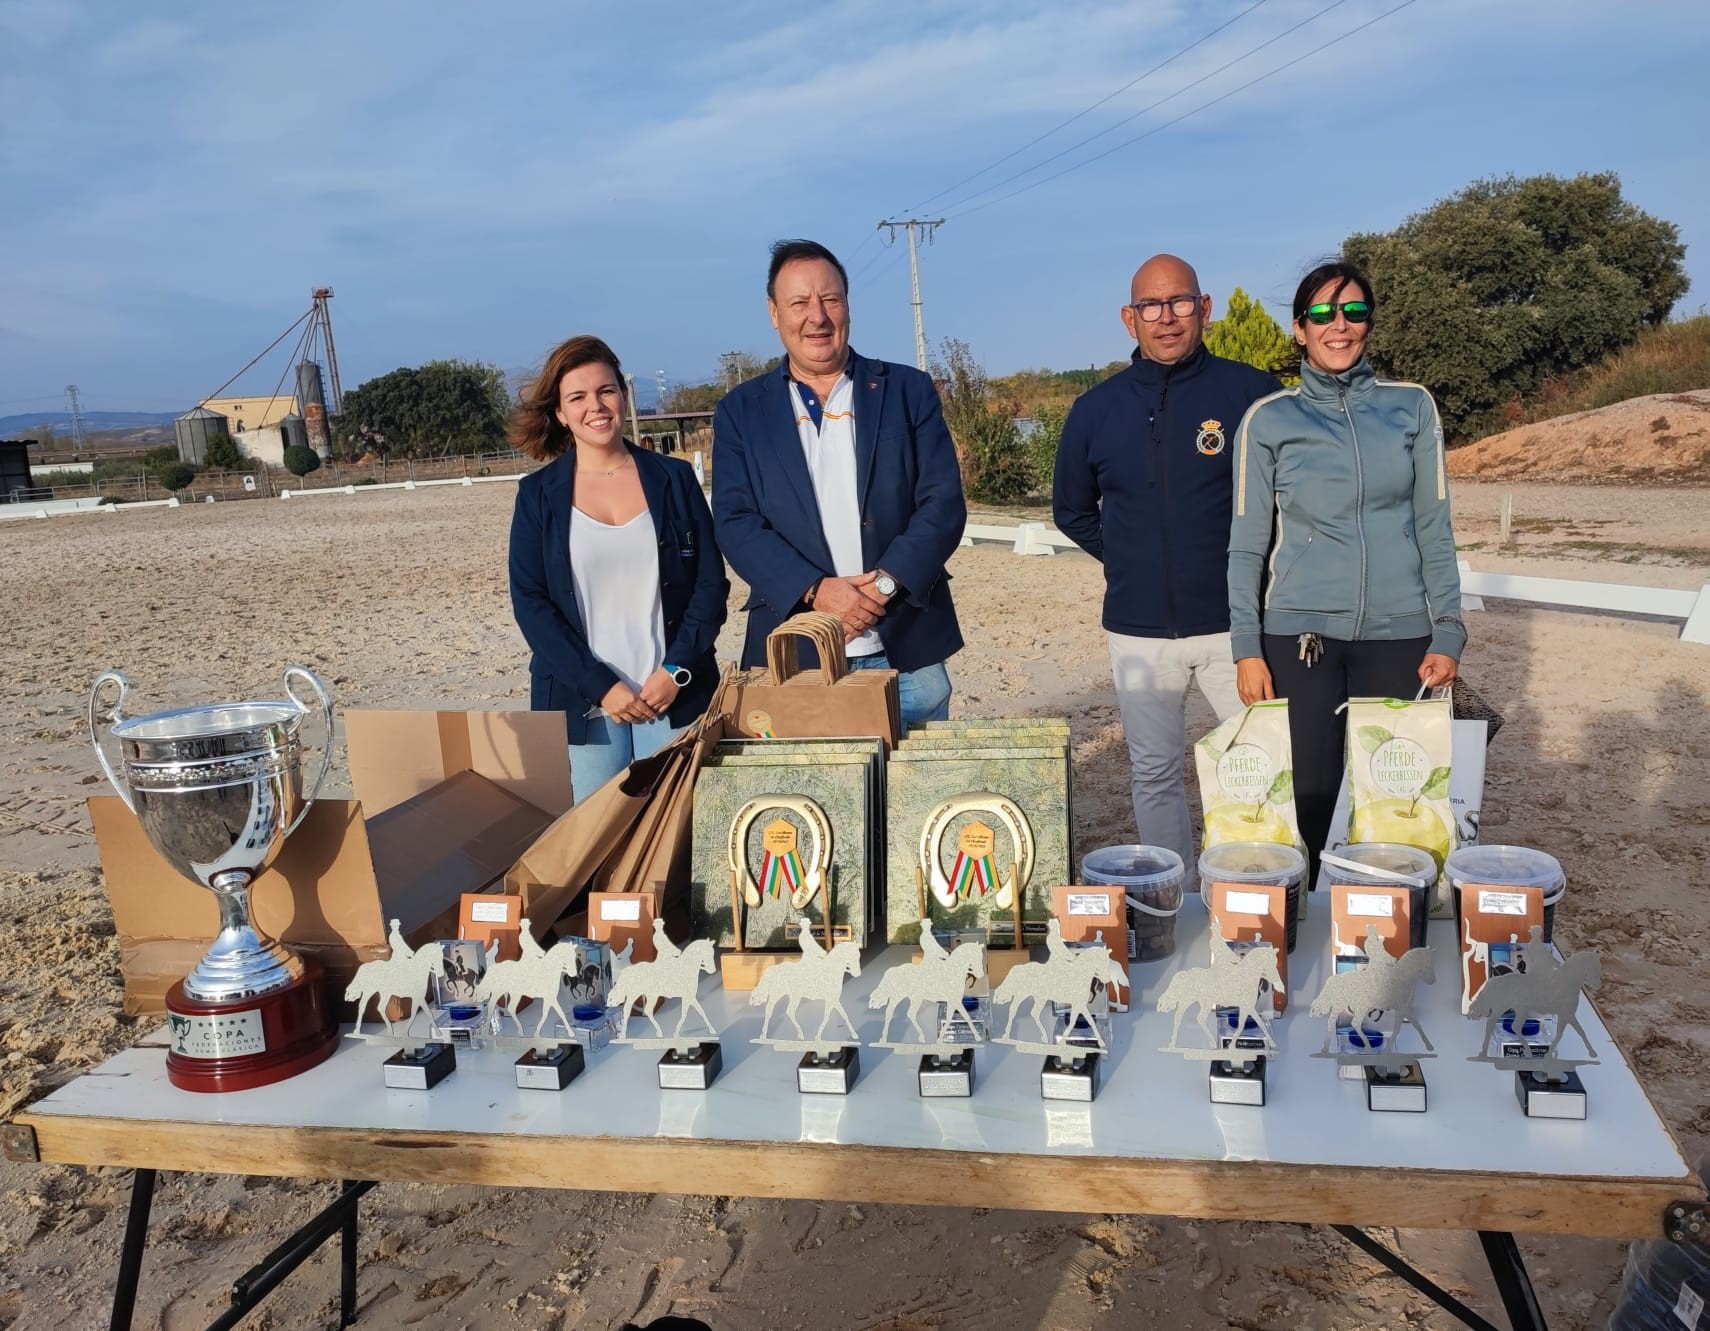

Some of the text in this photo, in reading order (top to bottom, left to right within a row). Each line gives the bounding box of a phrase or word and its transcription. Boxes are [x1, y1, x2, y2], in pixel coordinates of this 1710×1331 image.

[1228, 757, 1262, 773] PFERDE
[1383, 750, 1416, 767] PFERDE
[1224, 775, 1269, 788] LECKERBISSEN
[1377, 770, 1424, 782] LECKERBISSEN
[203, 1029, 245, 1040] COPA
